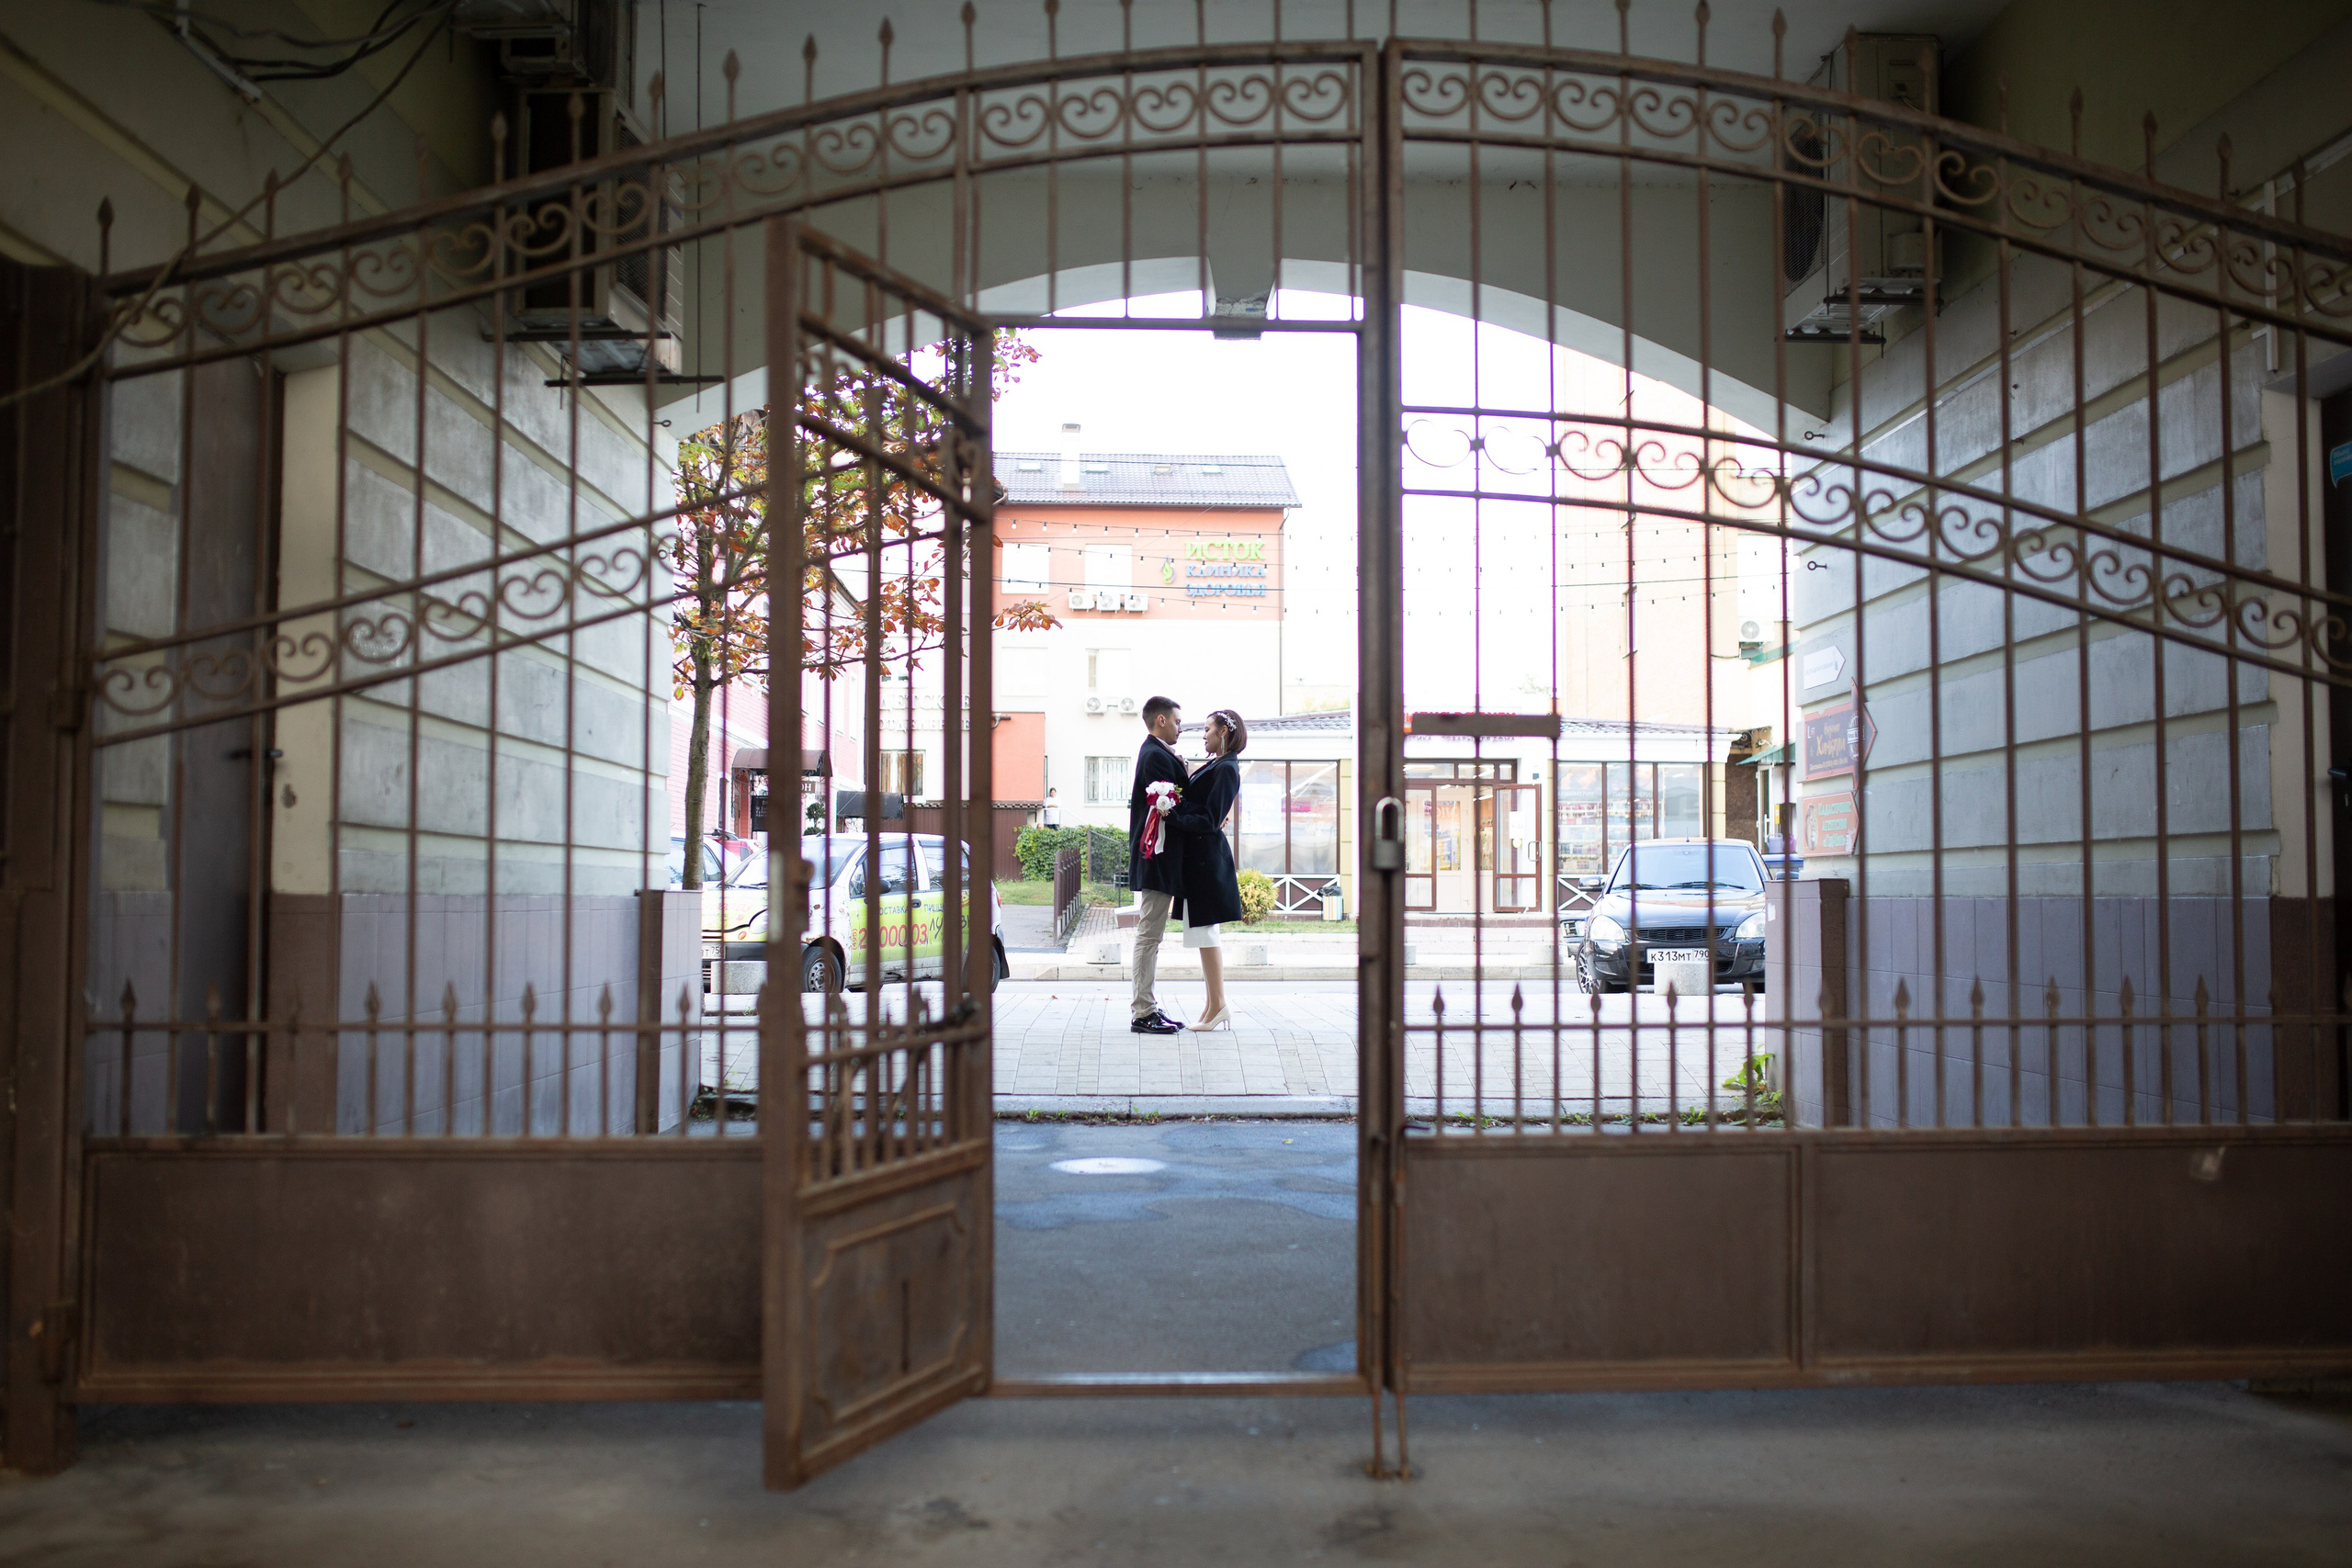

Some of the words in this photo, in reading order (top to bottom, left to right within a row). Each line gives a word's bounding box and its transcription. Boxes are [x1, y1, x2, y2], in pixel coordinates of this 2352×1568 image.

[1184, 541, 1266, 560] ИСТОК
[1185, 565, 1267, 578] КЛИНИКА
[1185, 583, 1267, 598] ЗДОРОВЬЯ
[879, 905, 908, 916] ОСТАВКА
[858, 923, 927, 949] 200003
